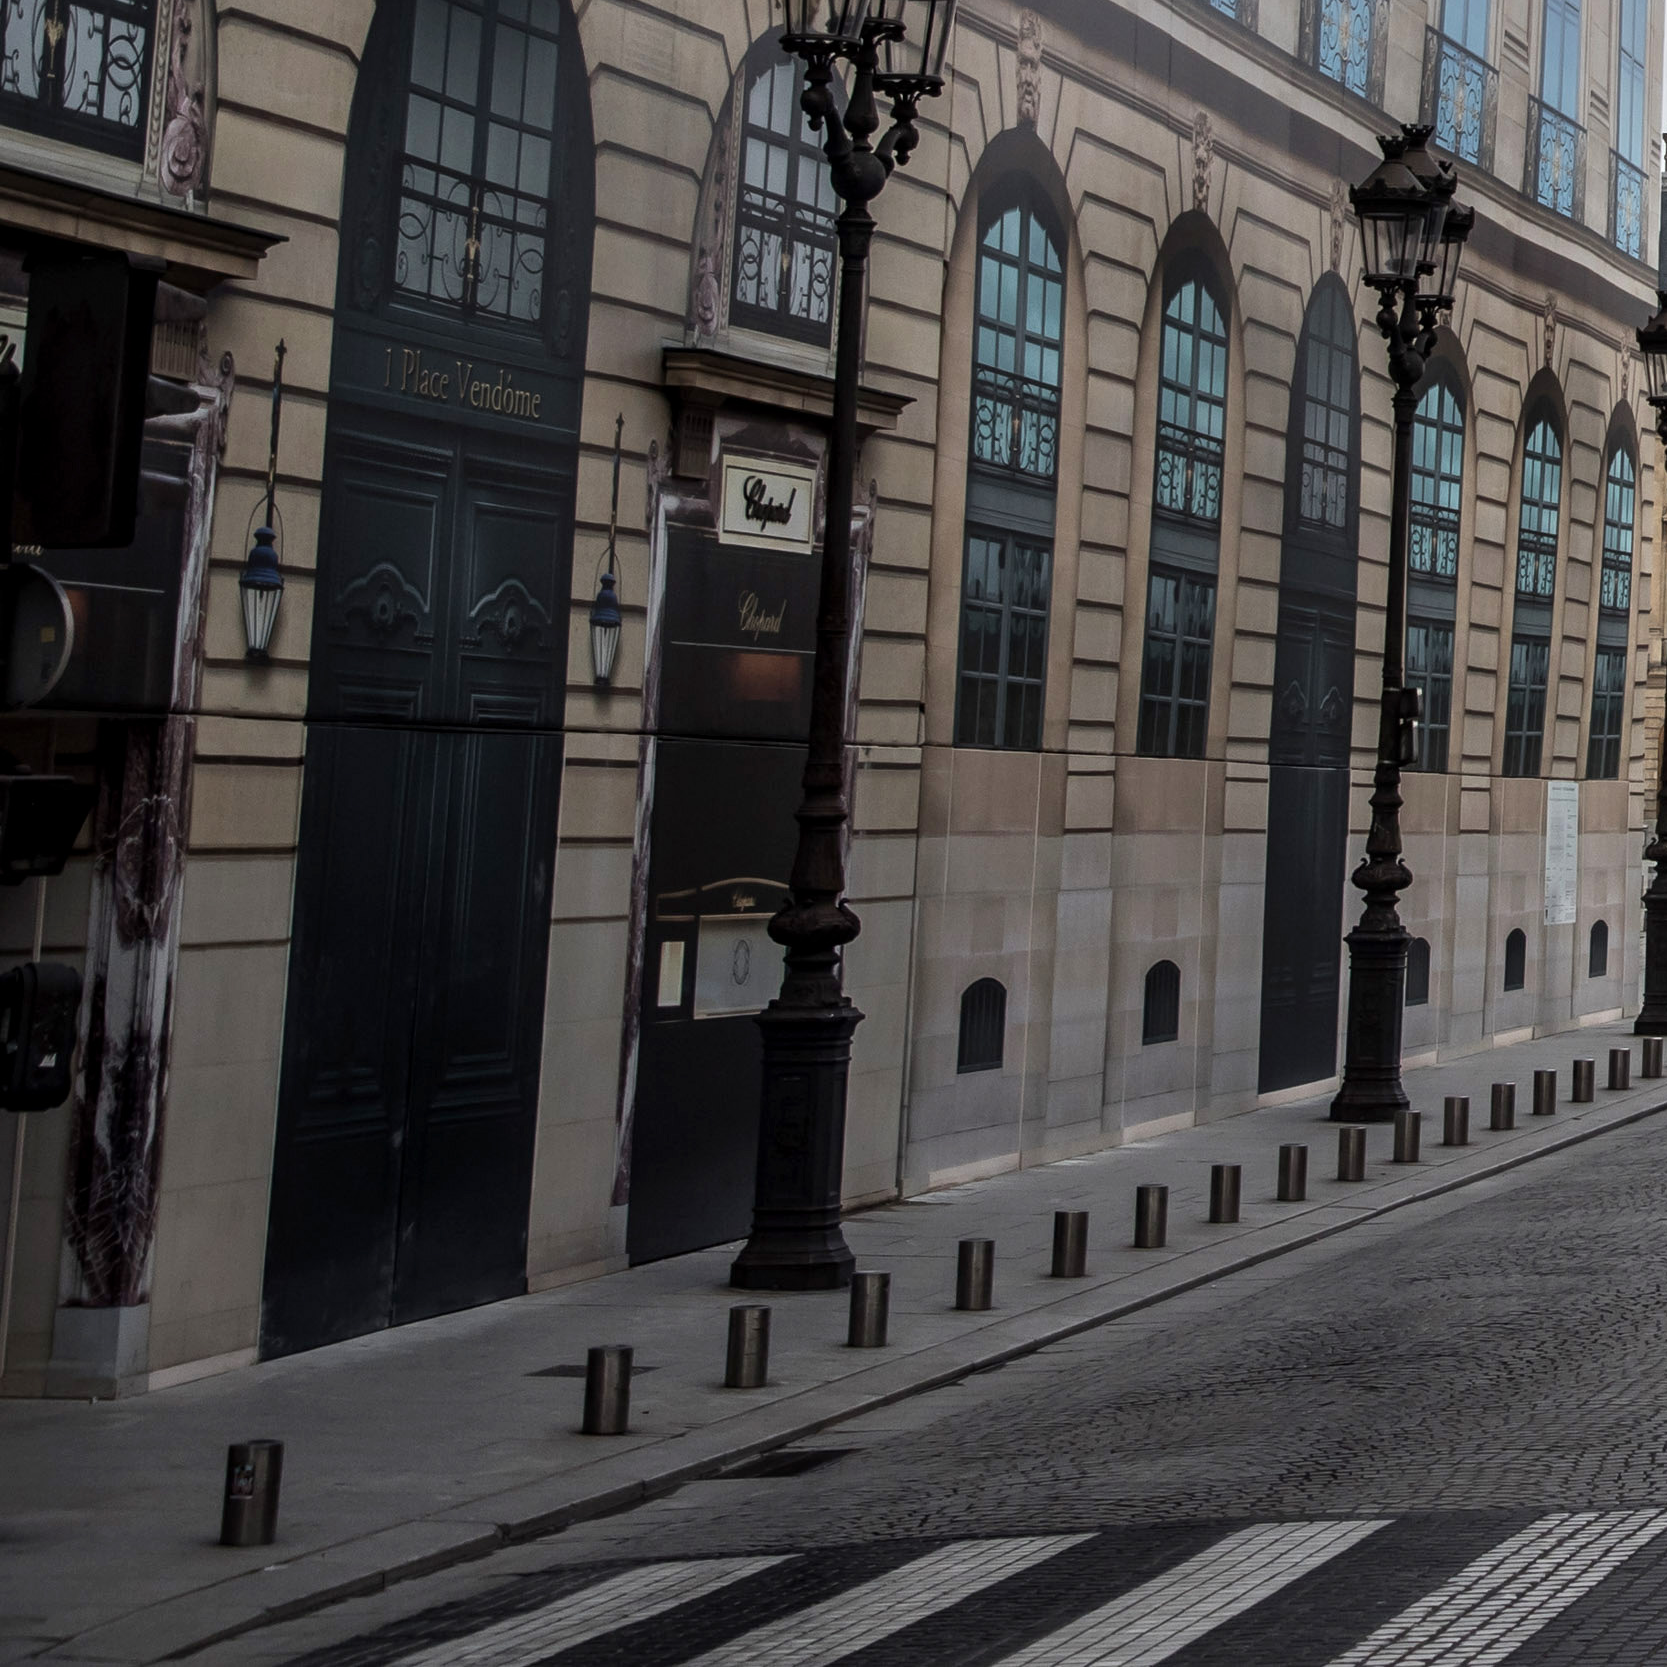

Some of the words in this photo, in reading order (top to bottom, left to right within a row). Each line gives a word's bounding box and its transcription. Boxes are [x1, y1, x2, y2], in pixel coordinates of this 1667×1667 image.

[400, 347, 449, 399] Place
[743, 476, 796, 532] Chopard
[738, 590, 787, 642] Chopard
